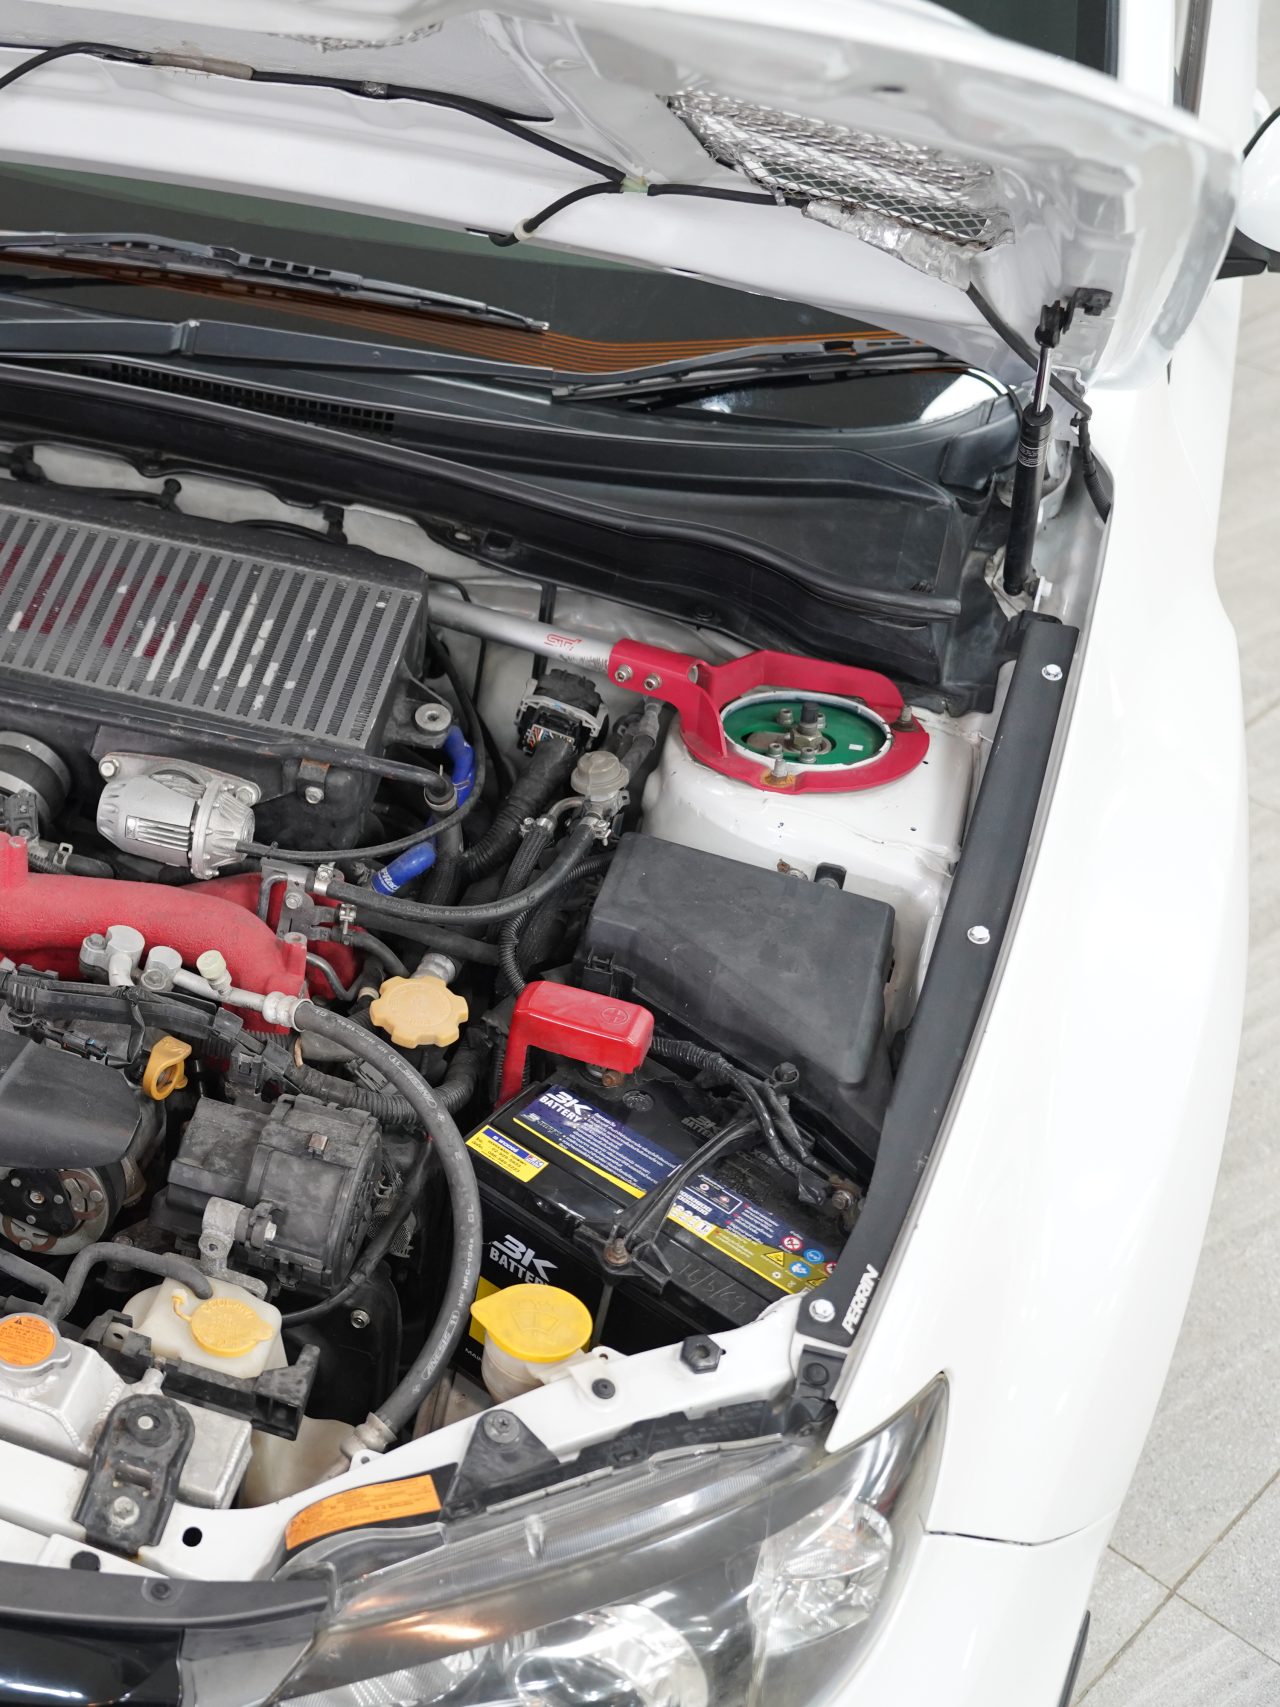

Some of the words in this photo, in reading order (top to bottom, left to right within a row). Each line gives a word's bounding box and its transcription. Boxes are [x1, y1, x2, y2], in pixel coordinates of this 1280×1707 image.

[539, 1095, 584, 1125] BATTERY
[543, 1090, 593, 1116] 3K
[491, 1234, 558, 1283] 3K
[841, 1263, 880, 1335] PERRIN
